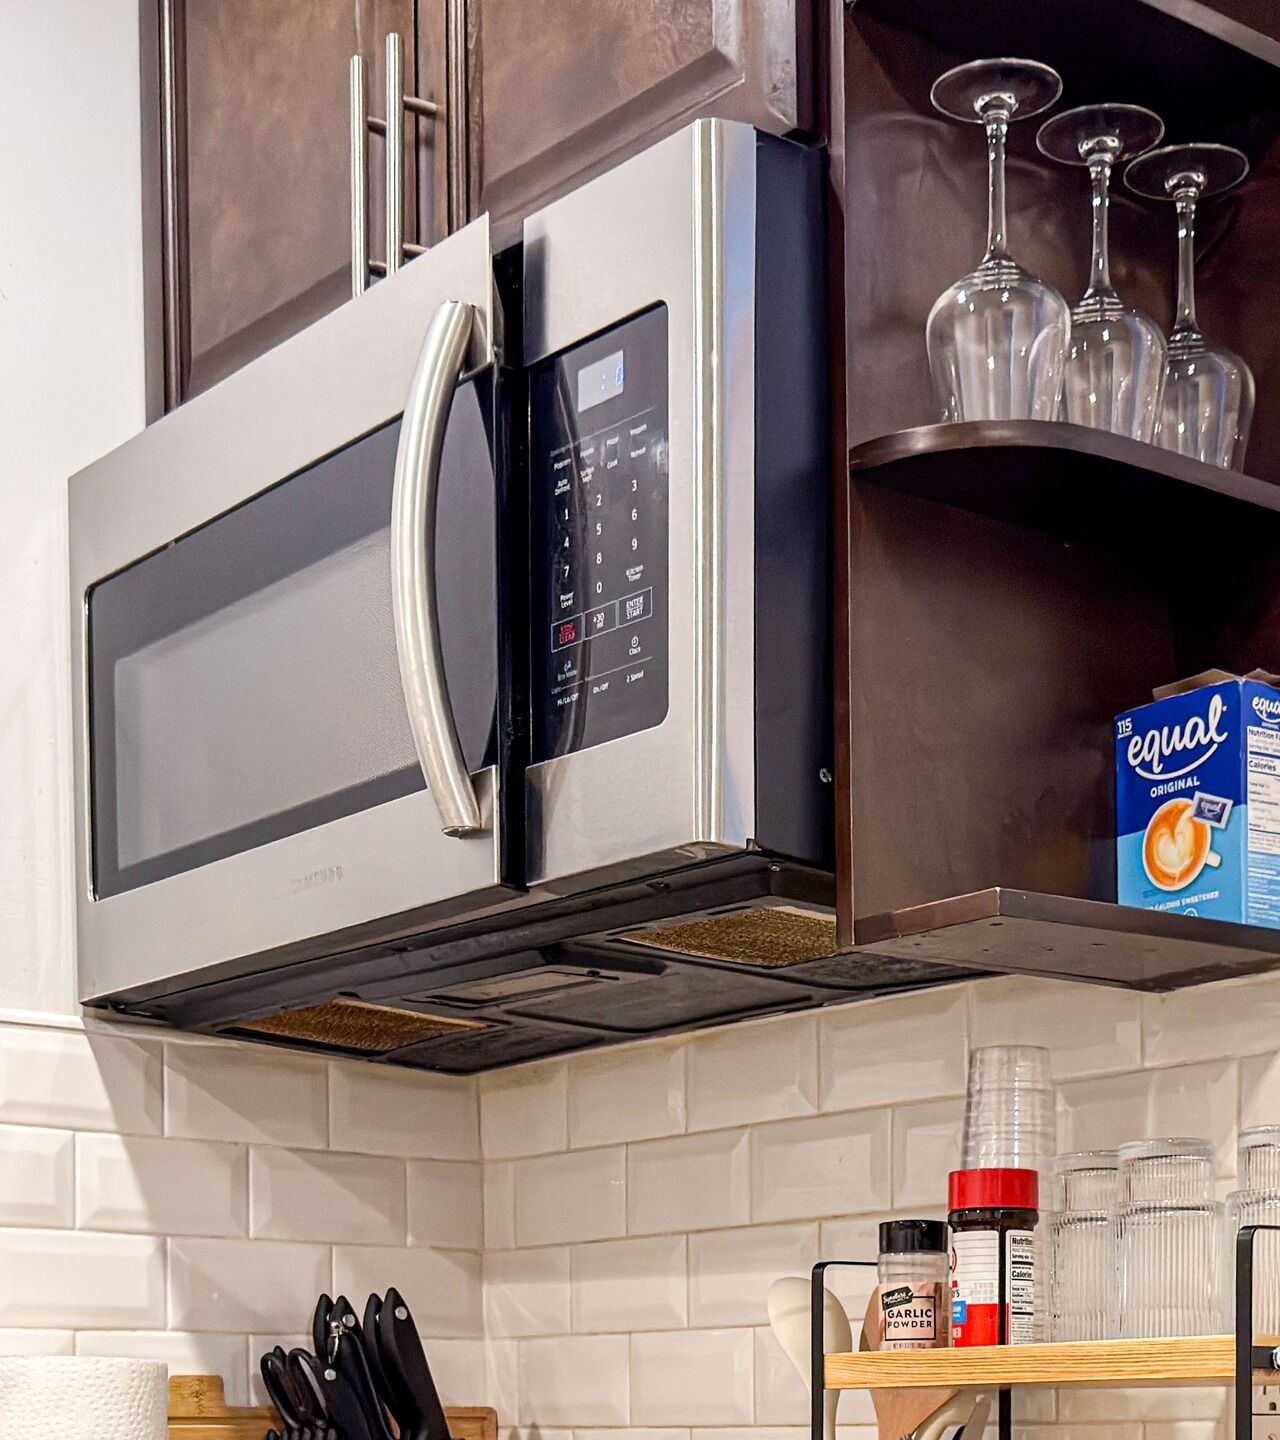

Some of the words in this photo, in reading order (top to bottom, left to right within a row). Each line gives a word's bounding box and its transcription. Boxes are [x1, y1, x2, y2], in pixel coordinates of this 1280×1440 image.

[631, 479, 638, 492] 3
[596, 494, 602, 507] 2
[564, 508, 569, 520] 1
[631, 508, 638, 520] 6
[596, 523, 602, 535] 5
[563, 536, 569, 548] 4
[631, 538, 638, 550] 9
[596, 552, 602, 564] 8
[563, 564, 570, 577] 7
[596, 582, 602, 593] 0
[626, 596, 644, 610] ENTER
[626, 607, 644, 620] START
[1117, 717, 1133, 734] 115
[1127, 694, 1228, 774] equal
[1248, 728, 1275, 740] Nutrition
[1248, 760, 1277, 772] Calories
[1150, 775, 1200, 798] ORIGINAL
[887, 1309, 932, 1319] GARLIC
[887, 1320, 932, 1328] POWDER
